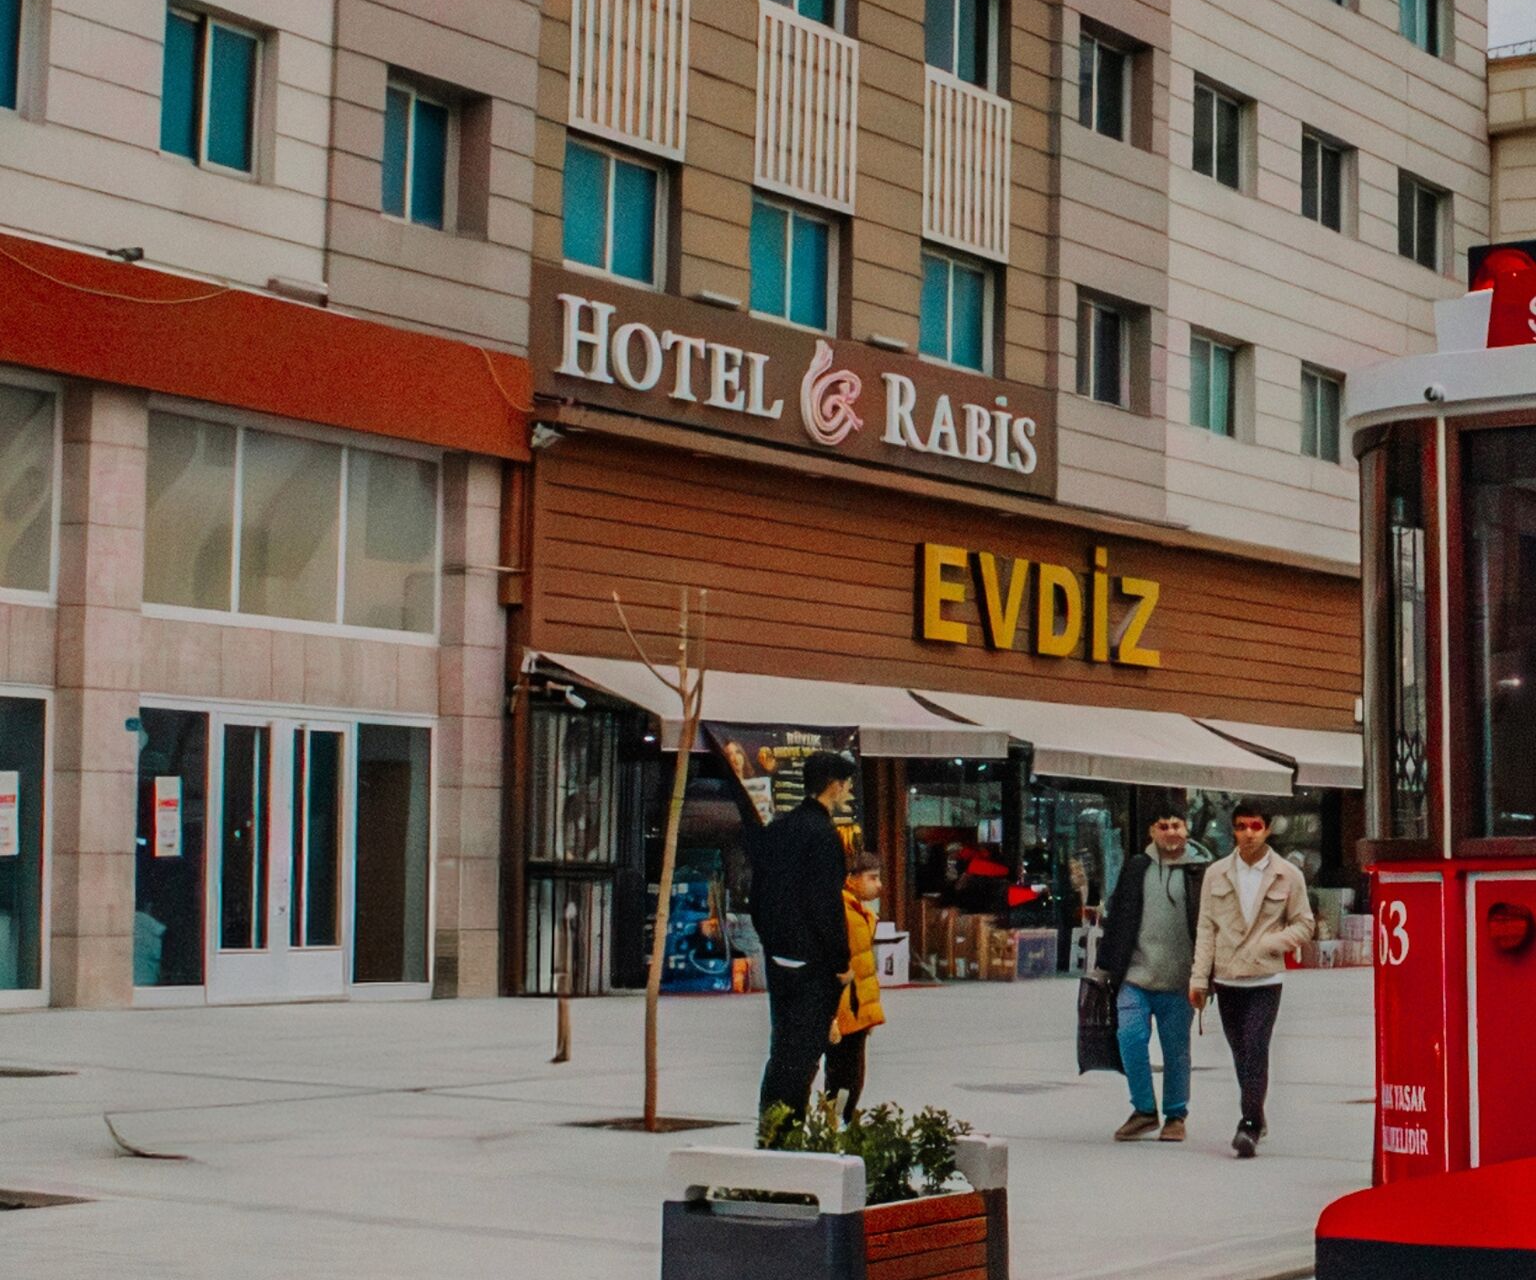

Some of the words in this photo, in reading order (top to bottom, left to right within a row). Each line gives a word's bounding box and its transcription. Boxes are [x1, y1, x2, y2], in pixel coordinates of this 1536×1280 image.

[554, 293, 784, 420] HOTEL
[880, 371, 1038, 474] RABİS
[917, 542, 1161, 668] EVDİZ
